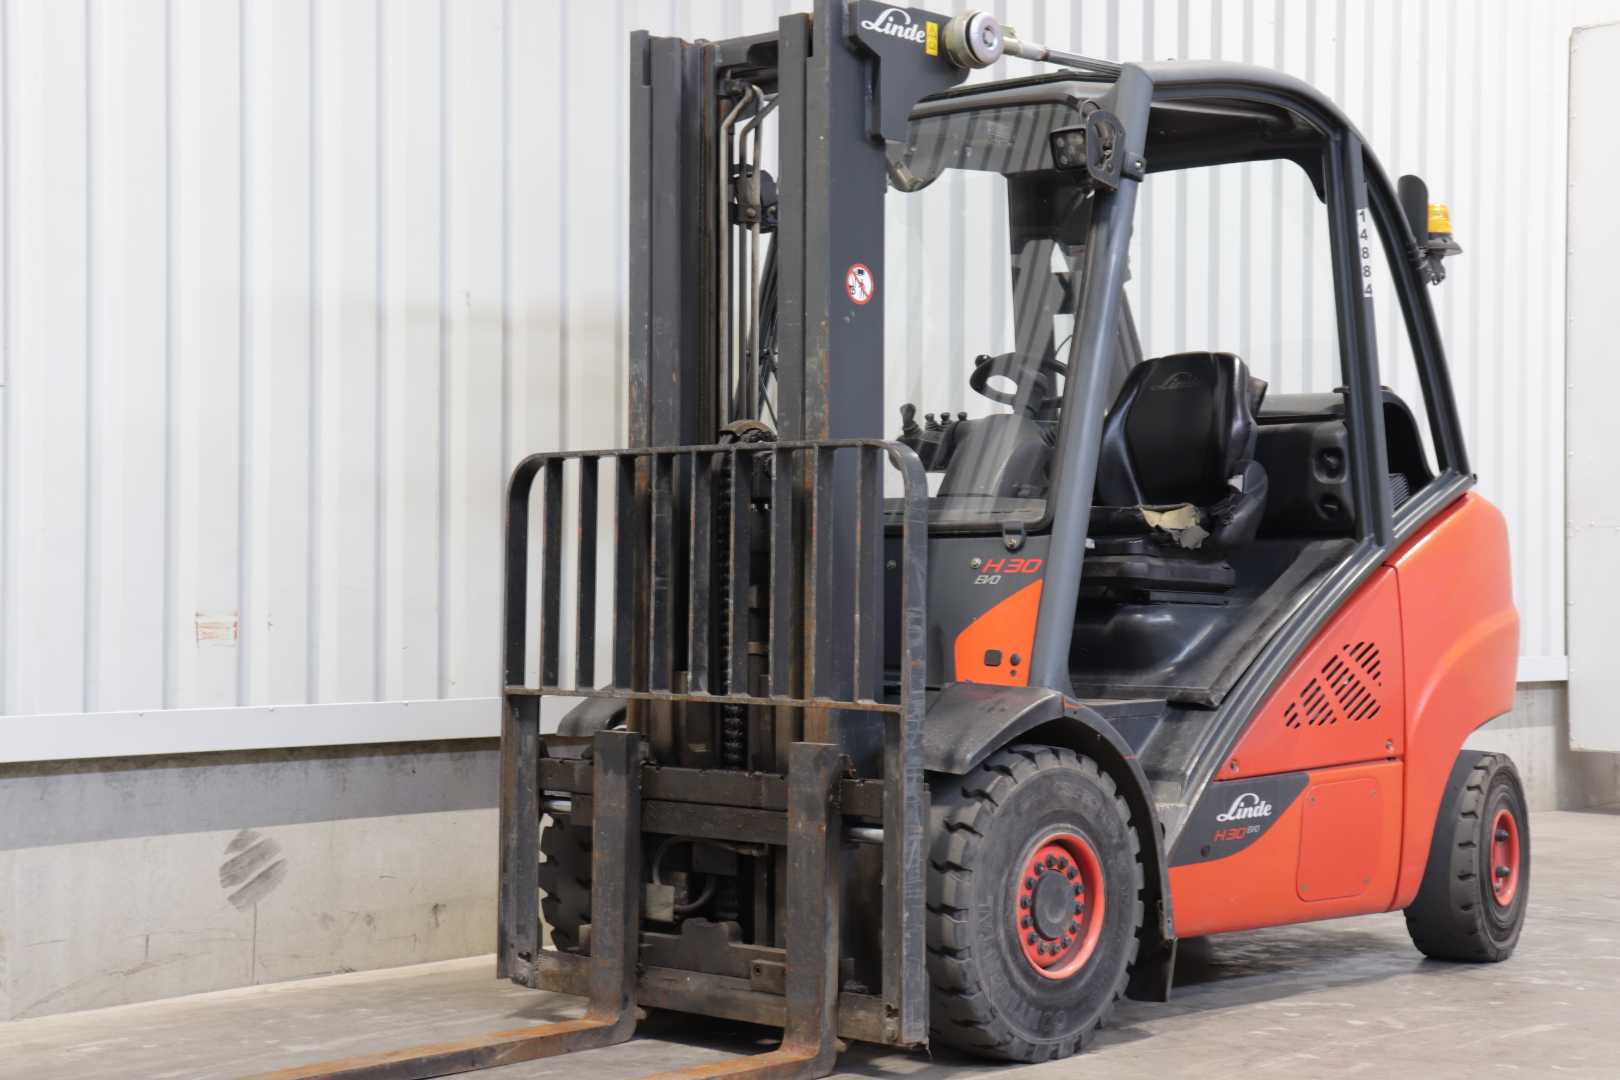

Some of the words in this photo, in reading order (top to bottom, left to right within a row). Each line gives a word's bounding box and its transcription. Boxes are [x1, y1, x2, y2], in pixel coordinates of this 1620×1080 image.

[861, 8, 926, 43] Linde
[1359, 210, 1372, 295] 14884
[1216, 792, 1273, 822] Linde
